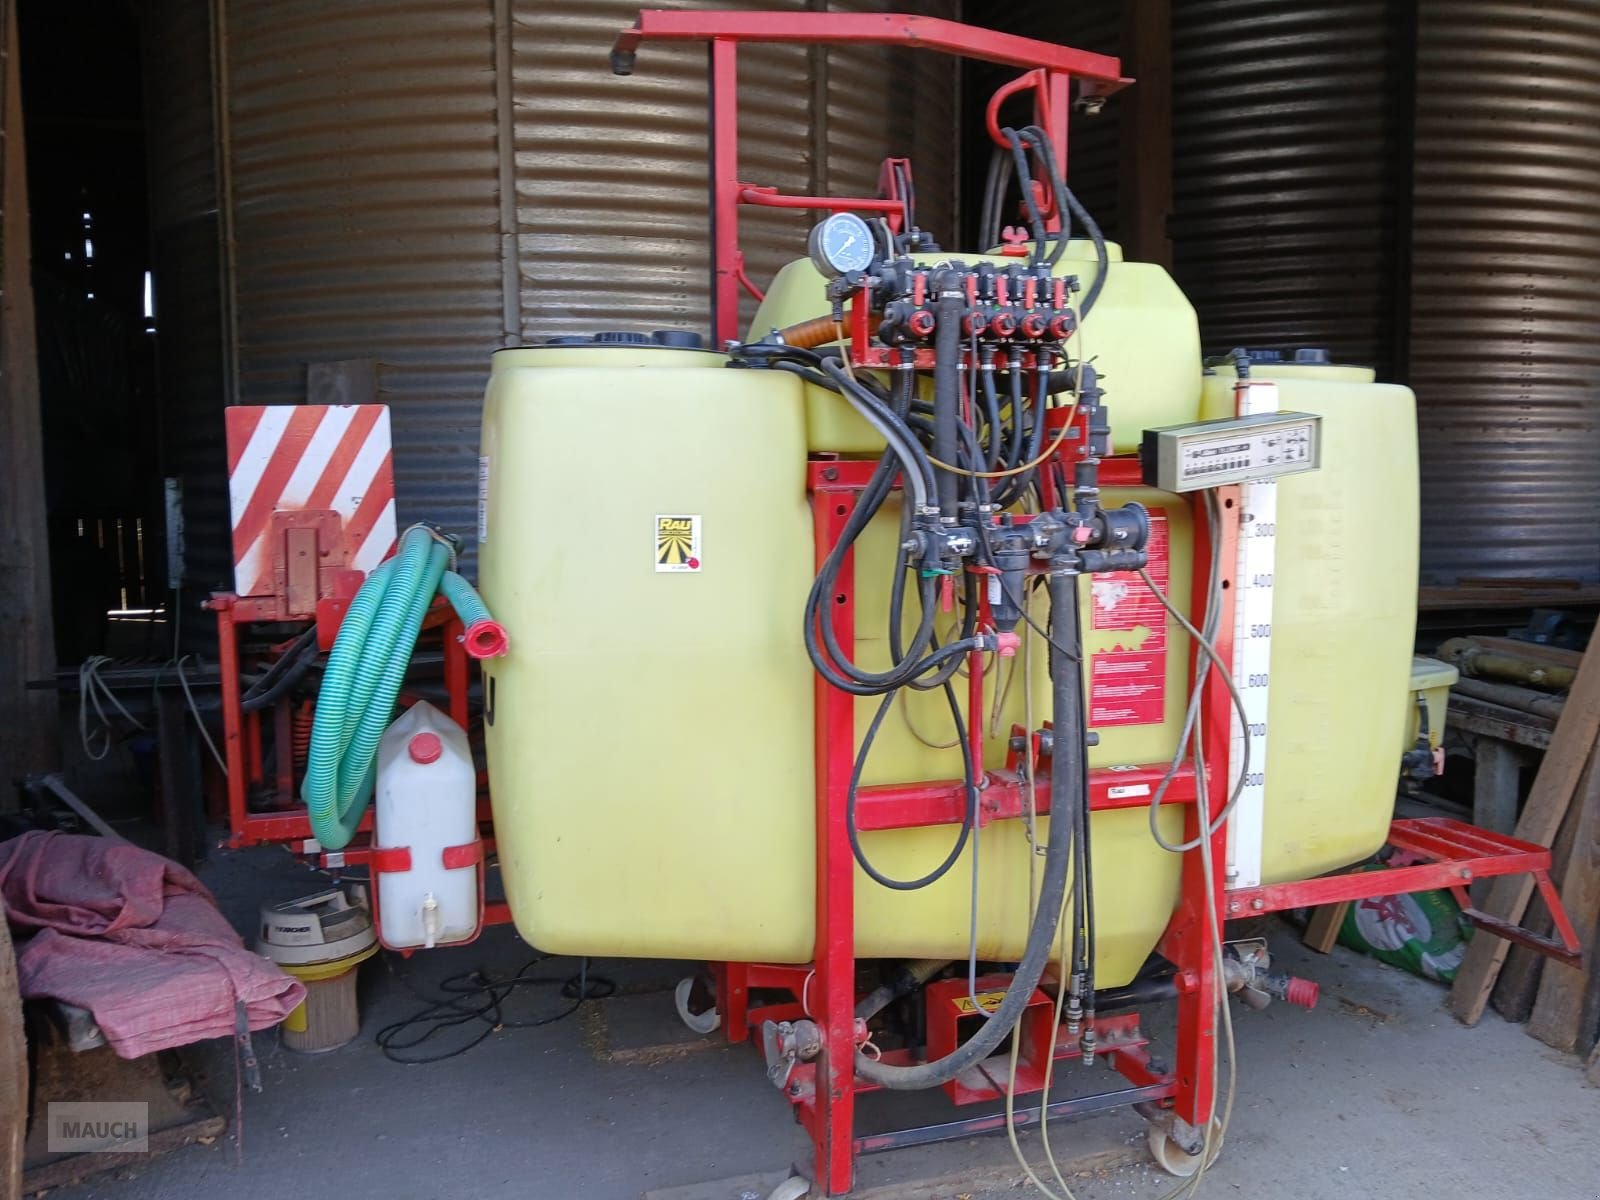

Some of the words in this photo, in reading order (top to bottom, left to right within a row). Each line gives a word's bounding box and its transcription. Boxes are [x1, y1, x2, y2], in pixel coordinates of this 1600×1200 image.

[659, 518, 690, 530] RAU
[1255, 523, 1275, 537] 300
[1253, 574, 1273, 587] 400
[1250, 624, 1271, 638] 500
[1248, 673, 1268, 687] 600
[1247, 723, 1266, 736] 700
